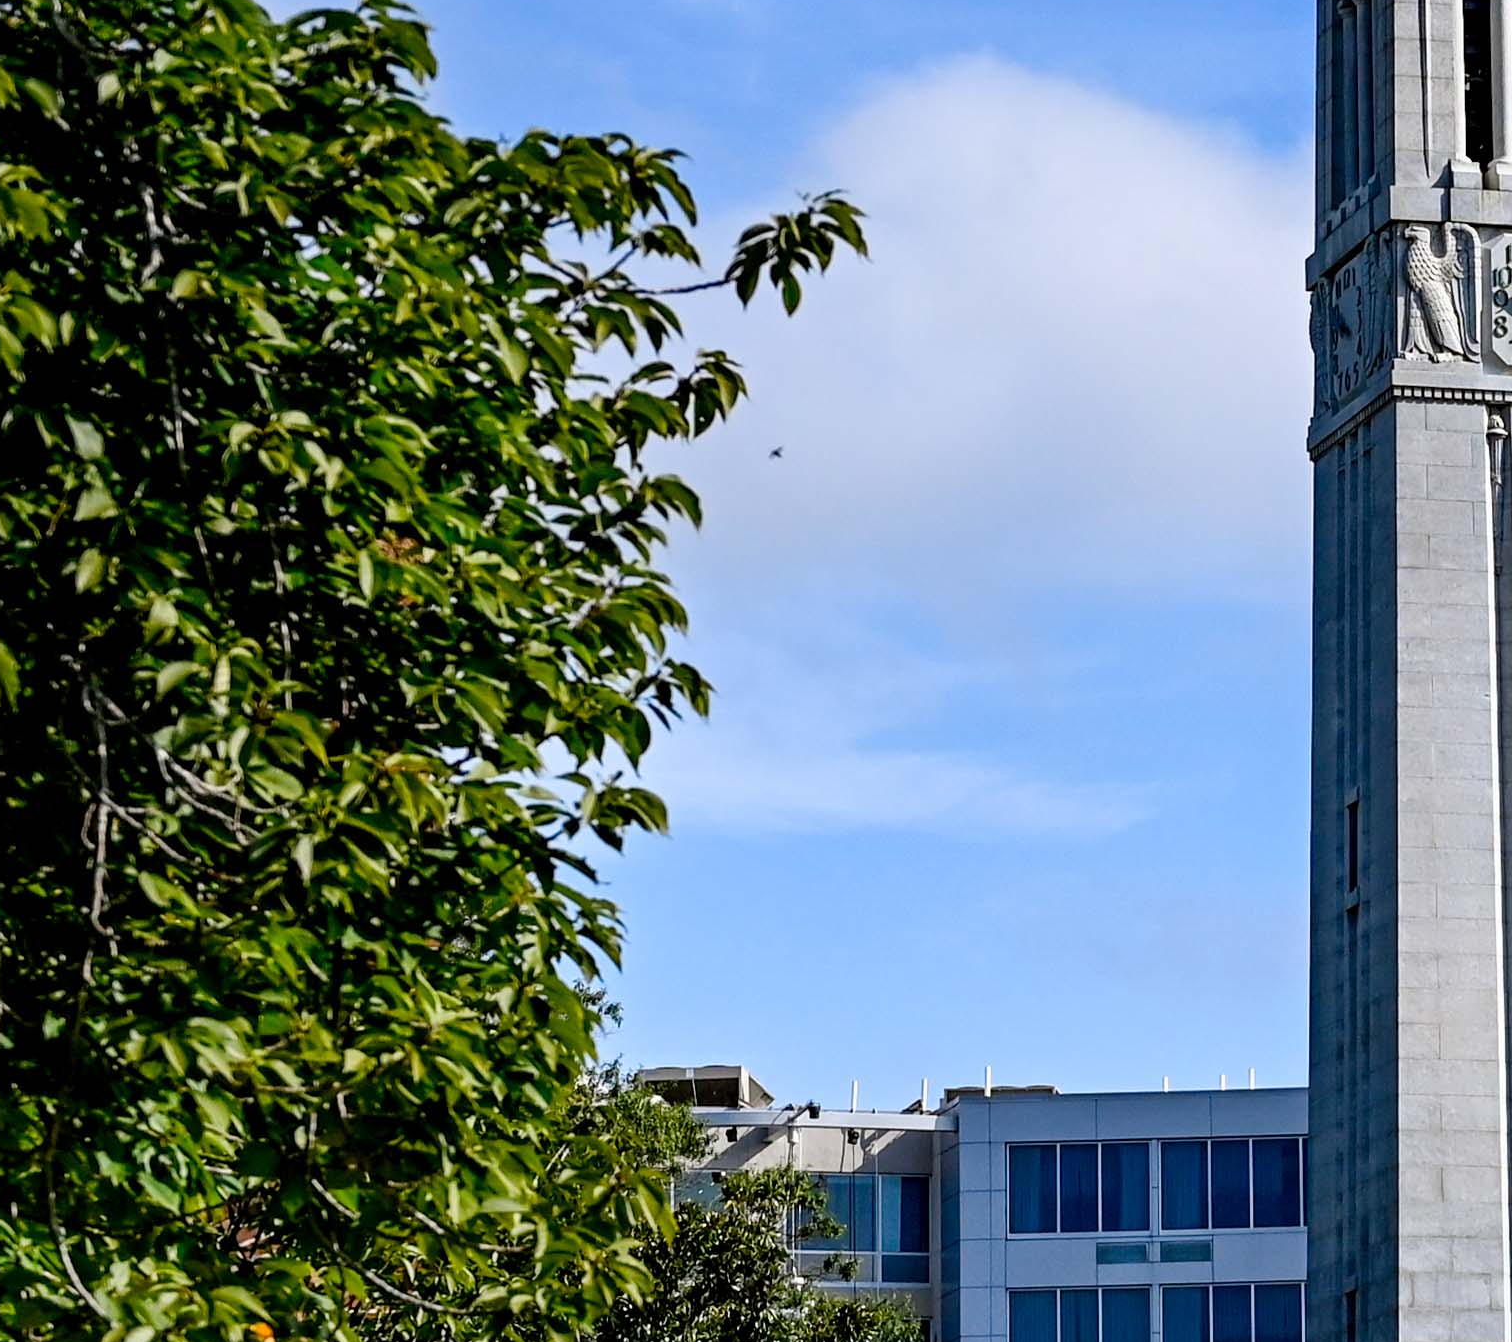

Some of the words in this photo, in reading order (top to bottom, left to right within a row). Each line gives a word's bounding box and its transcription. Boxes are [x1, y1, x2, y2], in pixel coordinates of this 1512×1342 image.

[1492, 267, 1512, 288] 10
[1493, 289, 1509, 314] 9
[1493, 316, 1509, 339] 8
